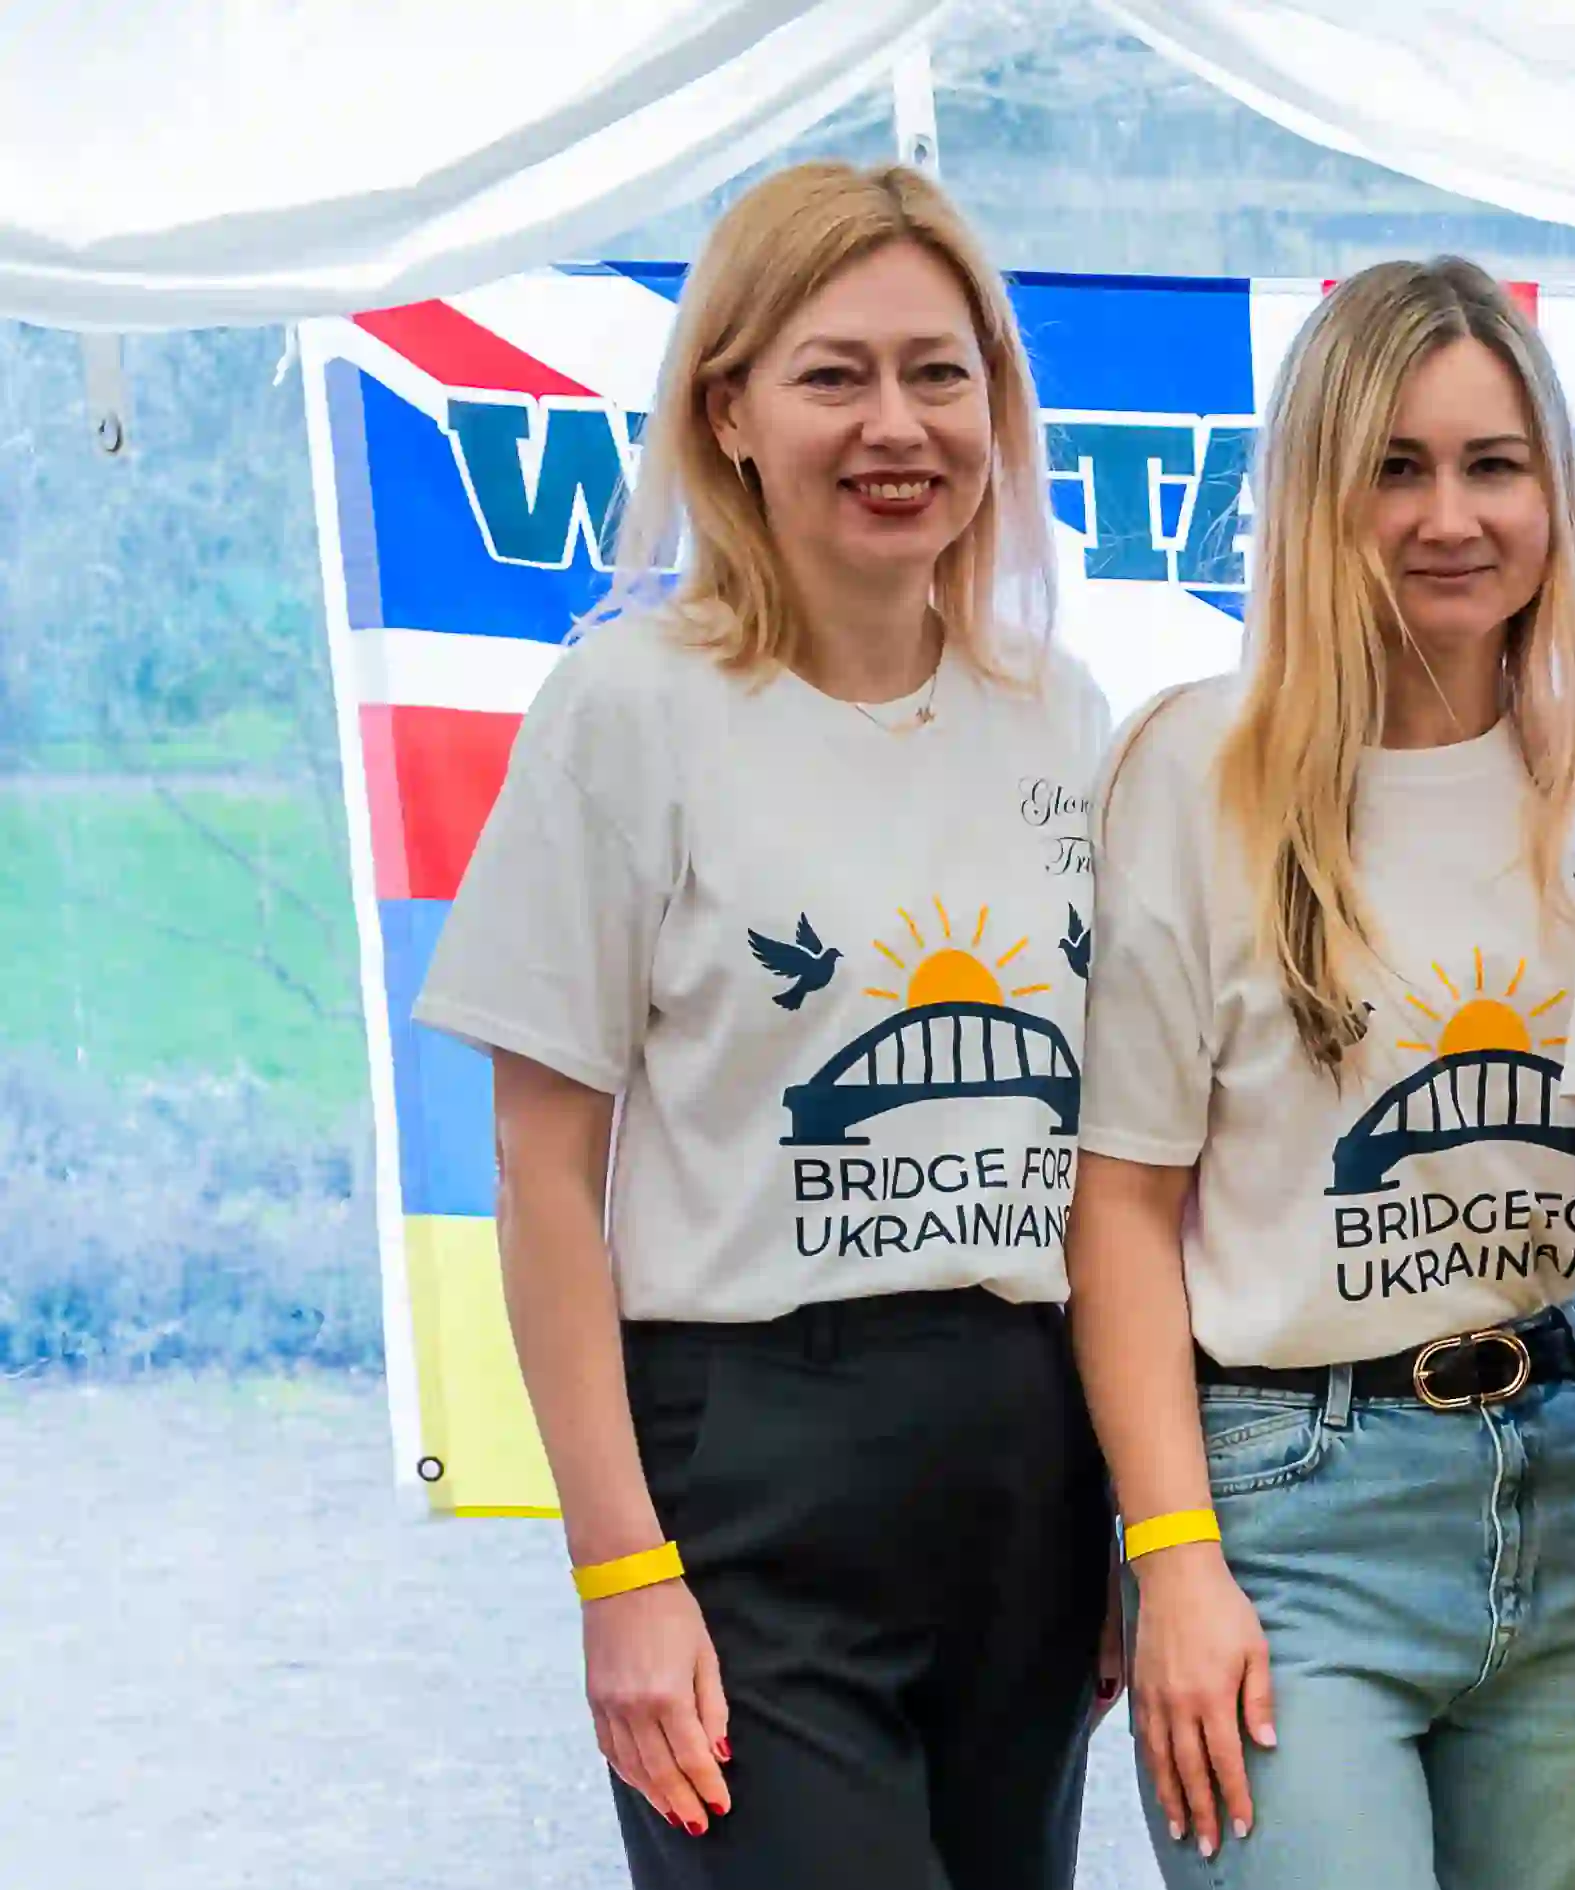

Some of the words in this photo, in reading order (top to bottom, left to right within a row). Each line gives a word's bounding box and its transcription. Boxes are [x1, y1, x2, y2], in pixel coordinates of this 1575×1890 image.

[794, 1148, 1008, 1202] BRIDGE
[1021, 1147, 1072, 1190] FOR
[1334, 1189, 1531, 1248] BRIDGE
